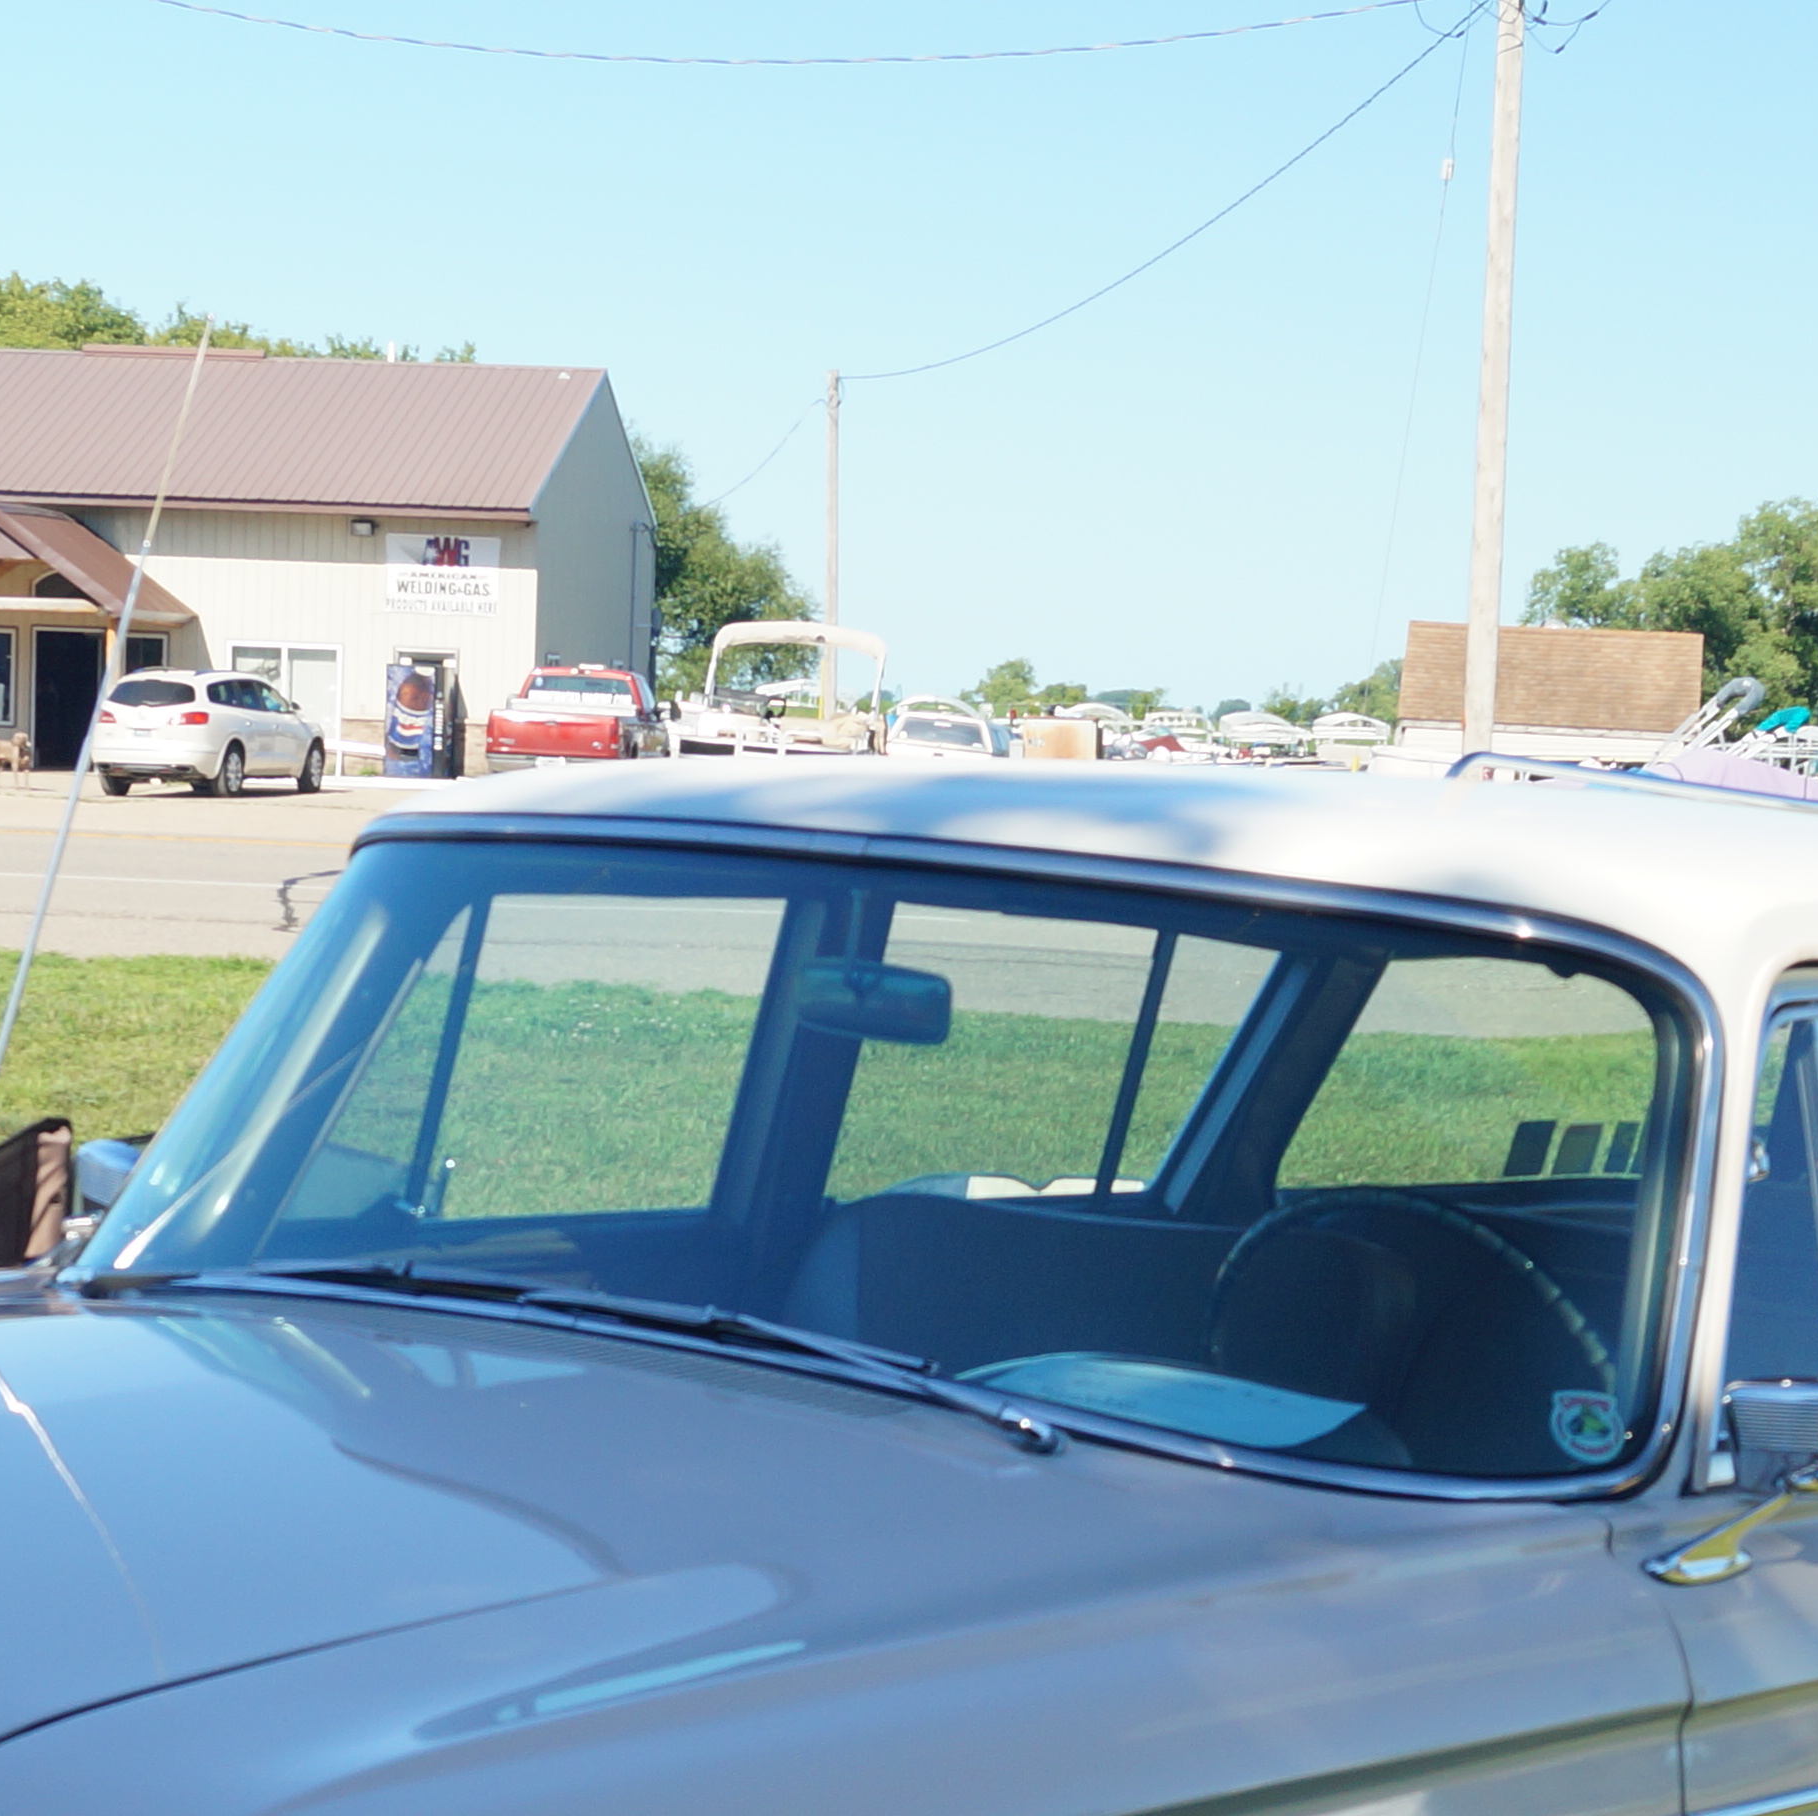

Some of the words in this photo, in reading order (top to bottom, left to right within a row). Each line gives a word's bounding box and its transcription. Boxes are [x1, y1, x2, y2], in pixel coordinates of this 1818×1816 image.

[421, 535, 470, 567] AWG
[409, 571, 477, 580] AMERICAN
[396, 579, 456, 595] WELDING
[463, 582, 490, 597] GAS
